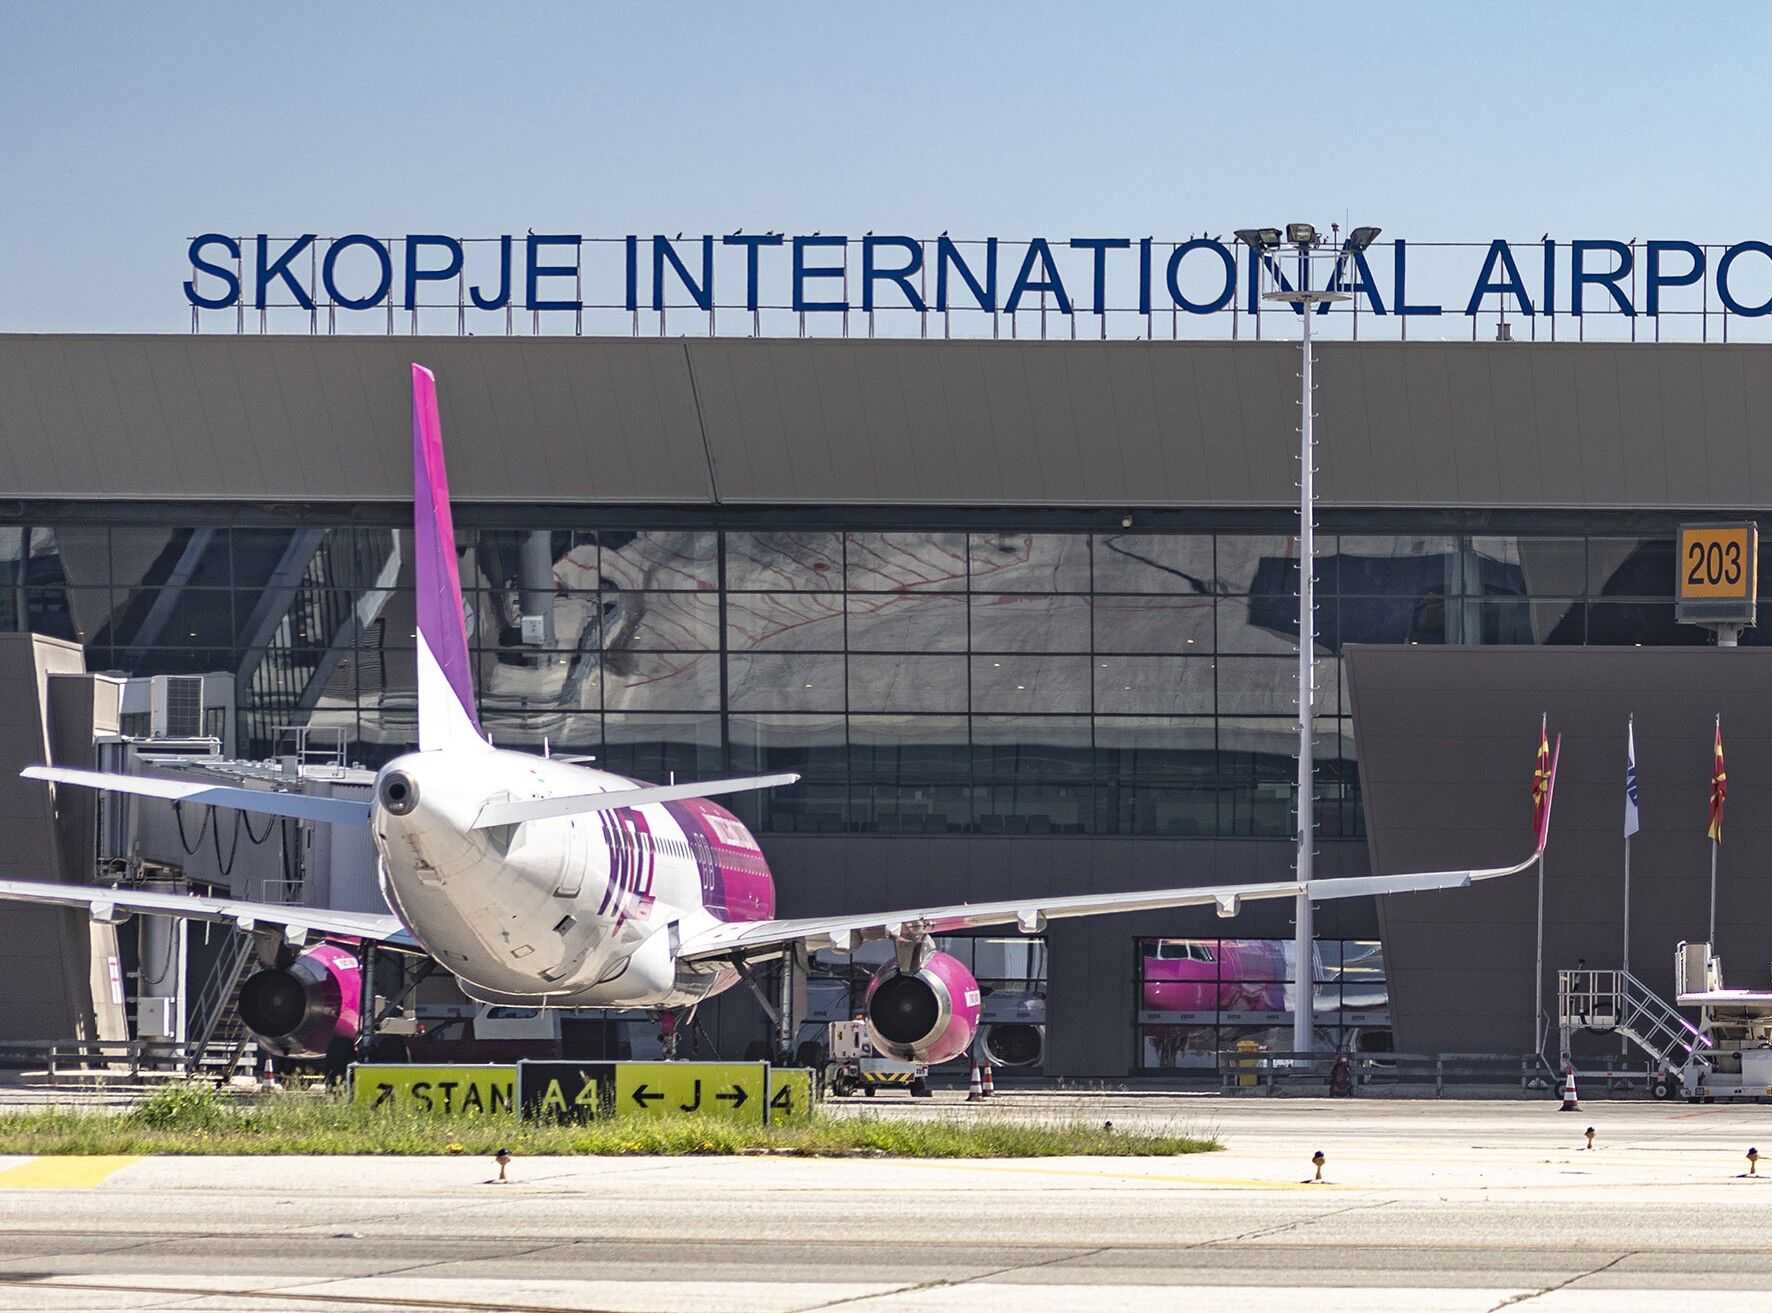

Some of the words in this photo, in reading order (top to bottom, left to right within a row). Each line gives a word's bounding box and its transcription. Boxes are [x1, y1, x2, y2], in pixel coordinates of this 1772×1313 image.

[182, 233, 583, 312] SKOPJE
[626, 234, 1442, 317] INTERNATIONAL
[1687, 541, 1742, 586] 203
[541, 1078, 601, 1113] A4
[680, 1079, 702, 1113] J
[769, 1083, 795, 1116] 4
